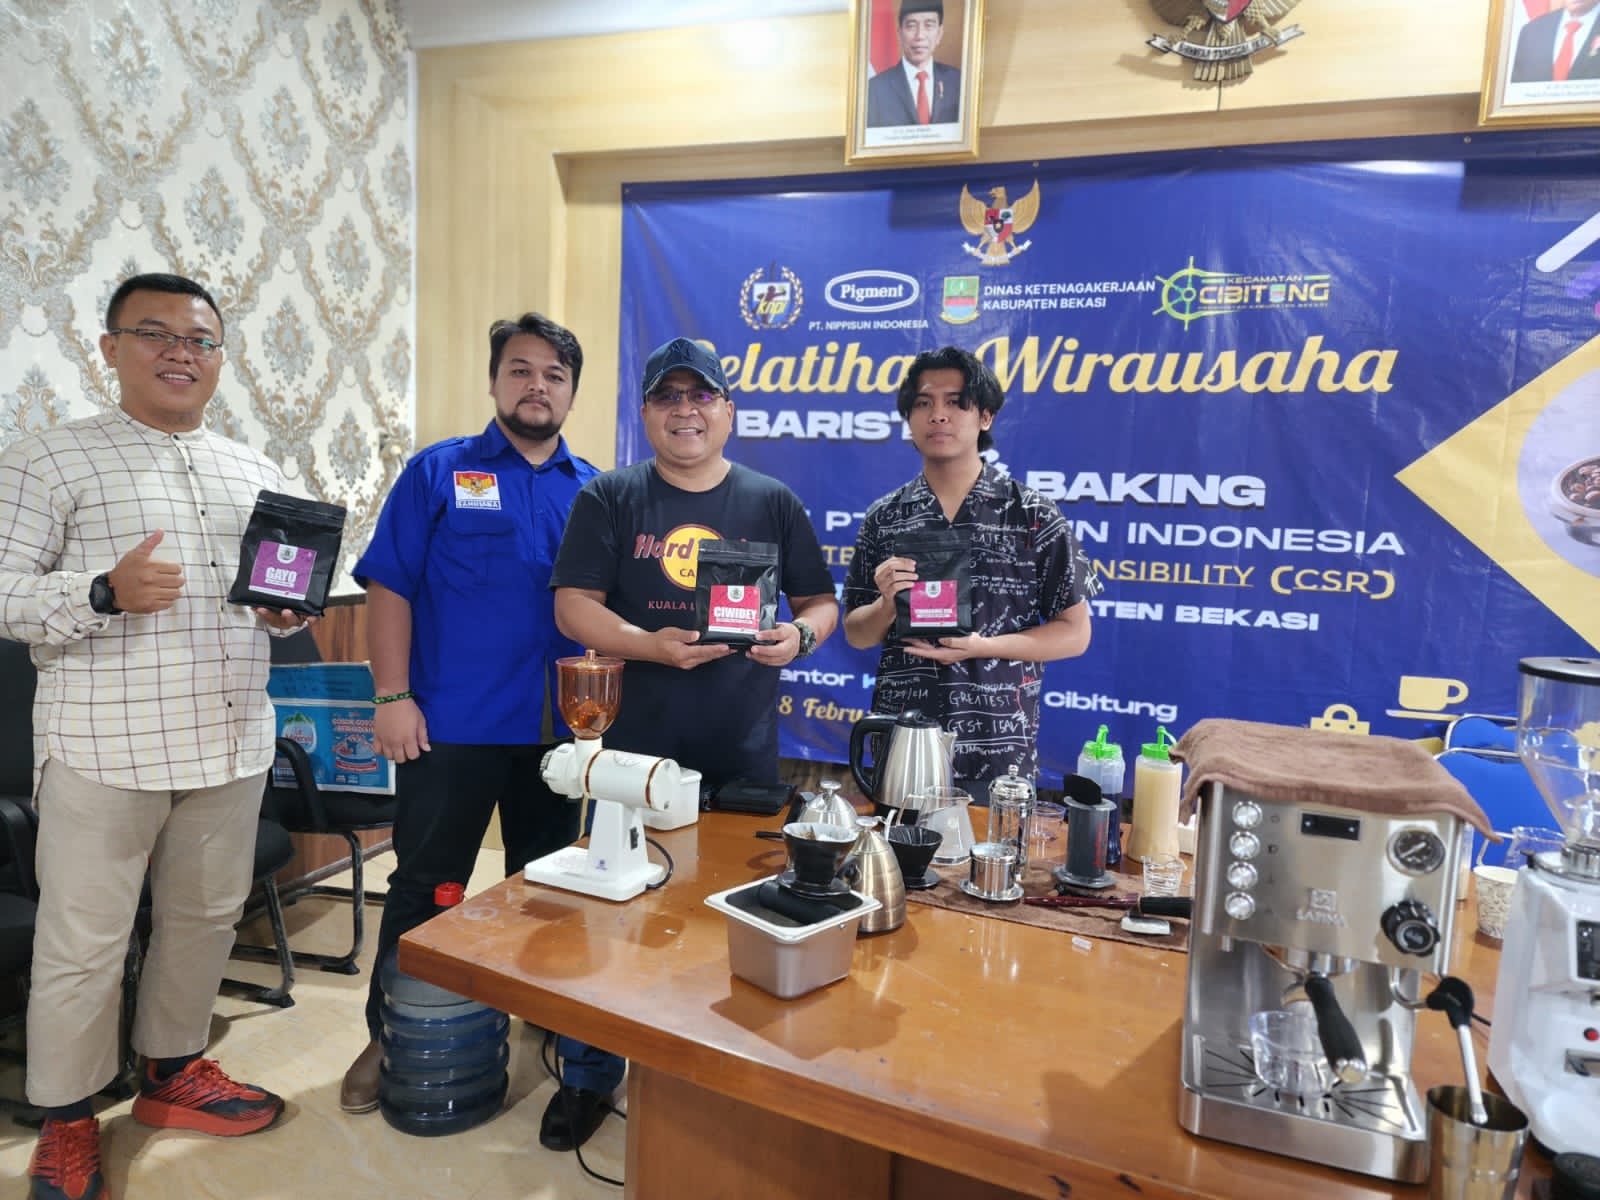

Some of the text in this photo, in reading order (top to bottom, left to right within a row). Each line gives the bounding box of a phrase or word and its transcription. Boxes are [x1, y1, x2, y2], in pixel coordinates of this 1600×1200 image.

[840, 284, 904, 302] Pigment
[985, 281, 1156, 296] DINAS KETENAGAKERJAAN
[983, 297, 1107, 310] KABUPATEN BEKASI
[808, 319, 929, 331] PT. NIPPISUN INDONESIA
[696, 335, 1398, 394] elatiha Wirausaha
[1026, 471, 1267, 508] BAKING
[633, 533, 695, 559] Hard
[1127, 522, 1406, 555] INDONESIA
[265, 566, 297, 584] GAYO
[1093, 559, 1256, 587] NSIBILITY
[648, 600, 687, 610] KUALA
[1175, 605, 1320, 631] BEKASI
[779, 668, 854, 687] antor
[1044, 691, 1178, 723] Cibitung
[803, 698, 864, 723] Febru
